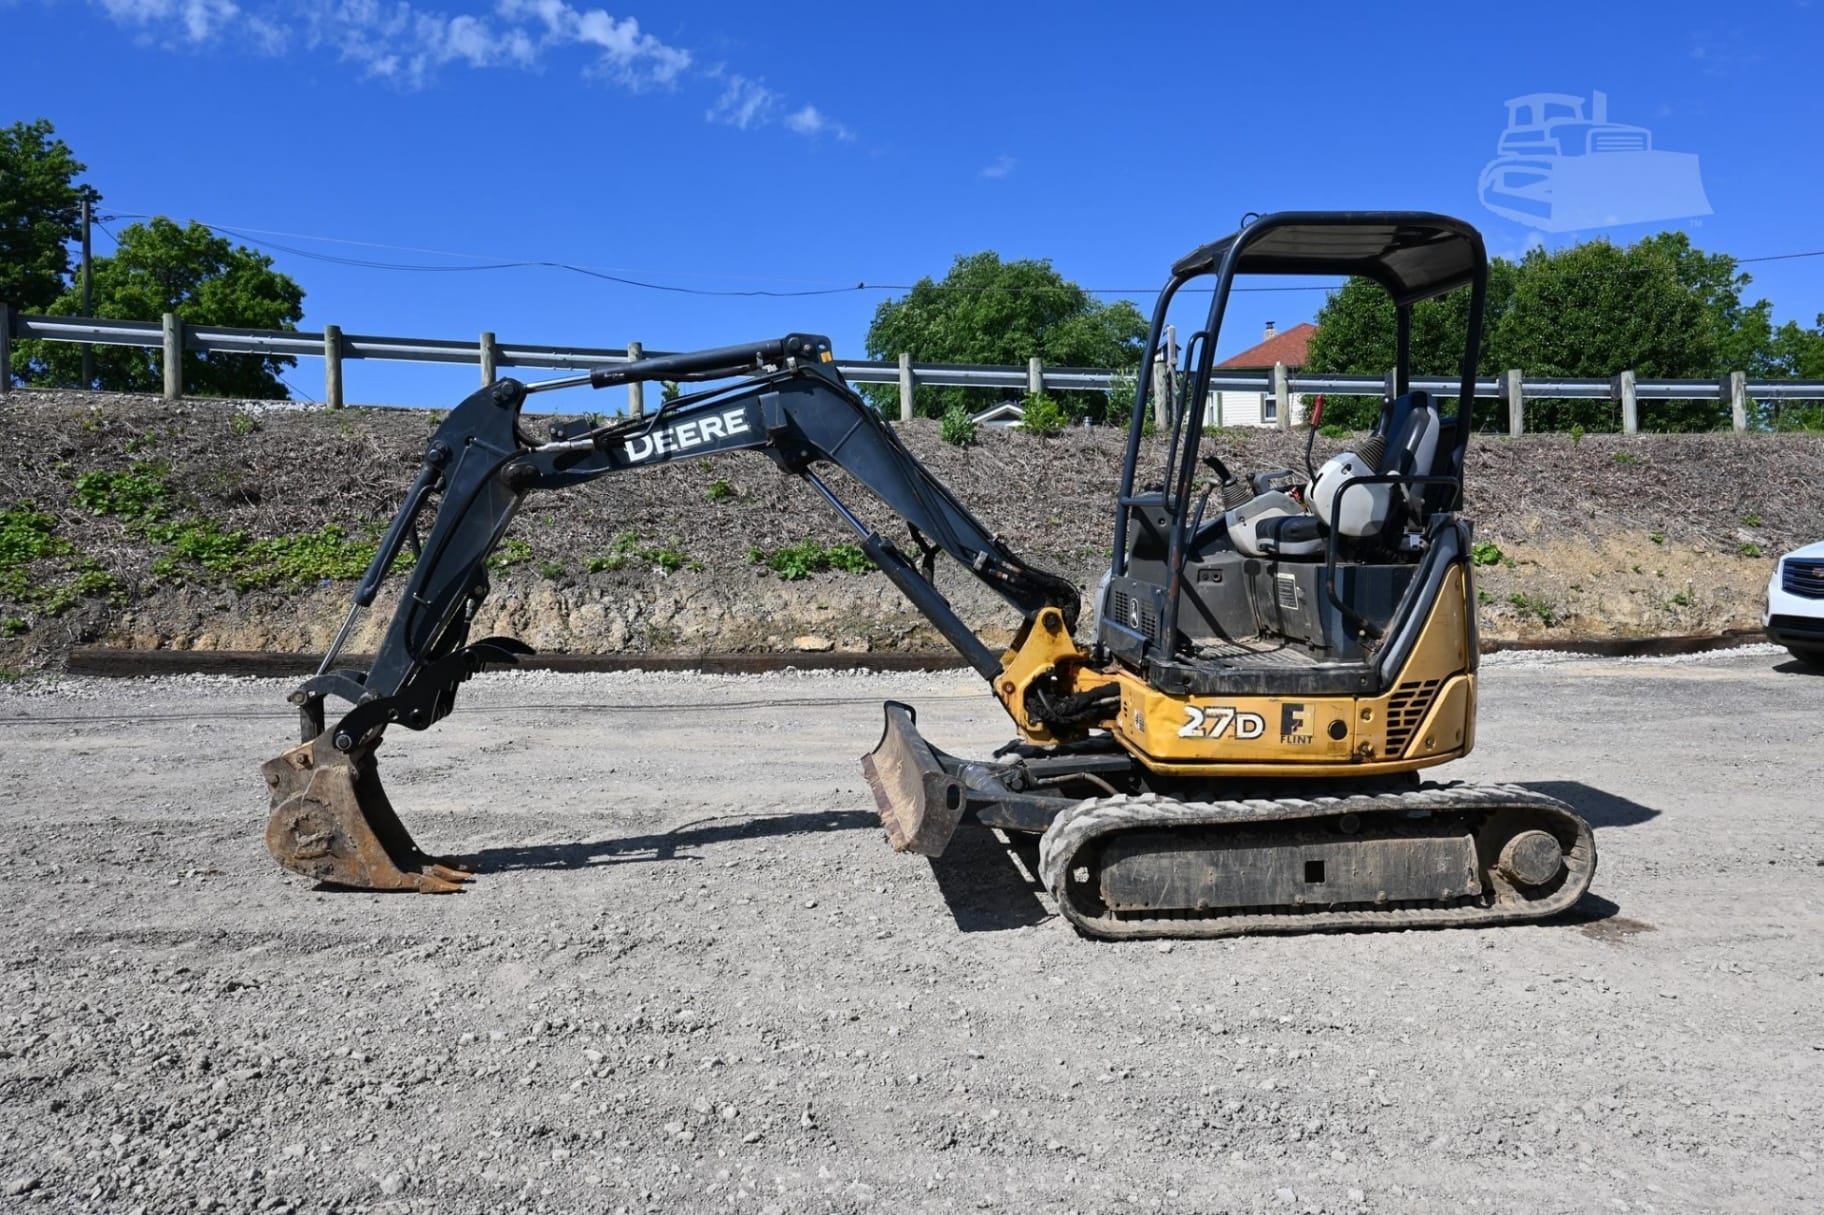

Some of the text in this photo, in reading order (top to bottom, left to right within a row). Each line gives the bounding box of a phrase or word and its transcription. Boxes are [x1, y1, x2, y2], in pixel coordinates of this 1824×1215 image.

[624, 407, 749, 462] DEERE
[1178, 705, 1266, 740] 27D
[1280, 735, 1313, 745] FLINT
